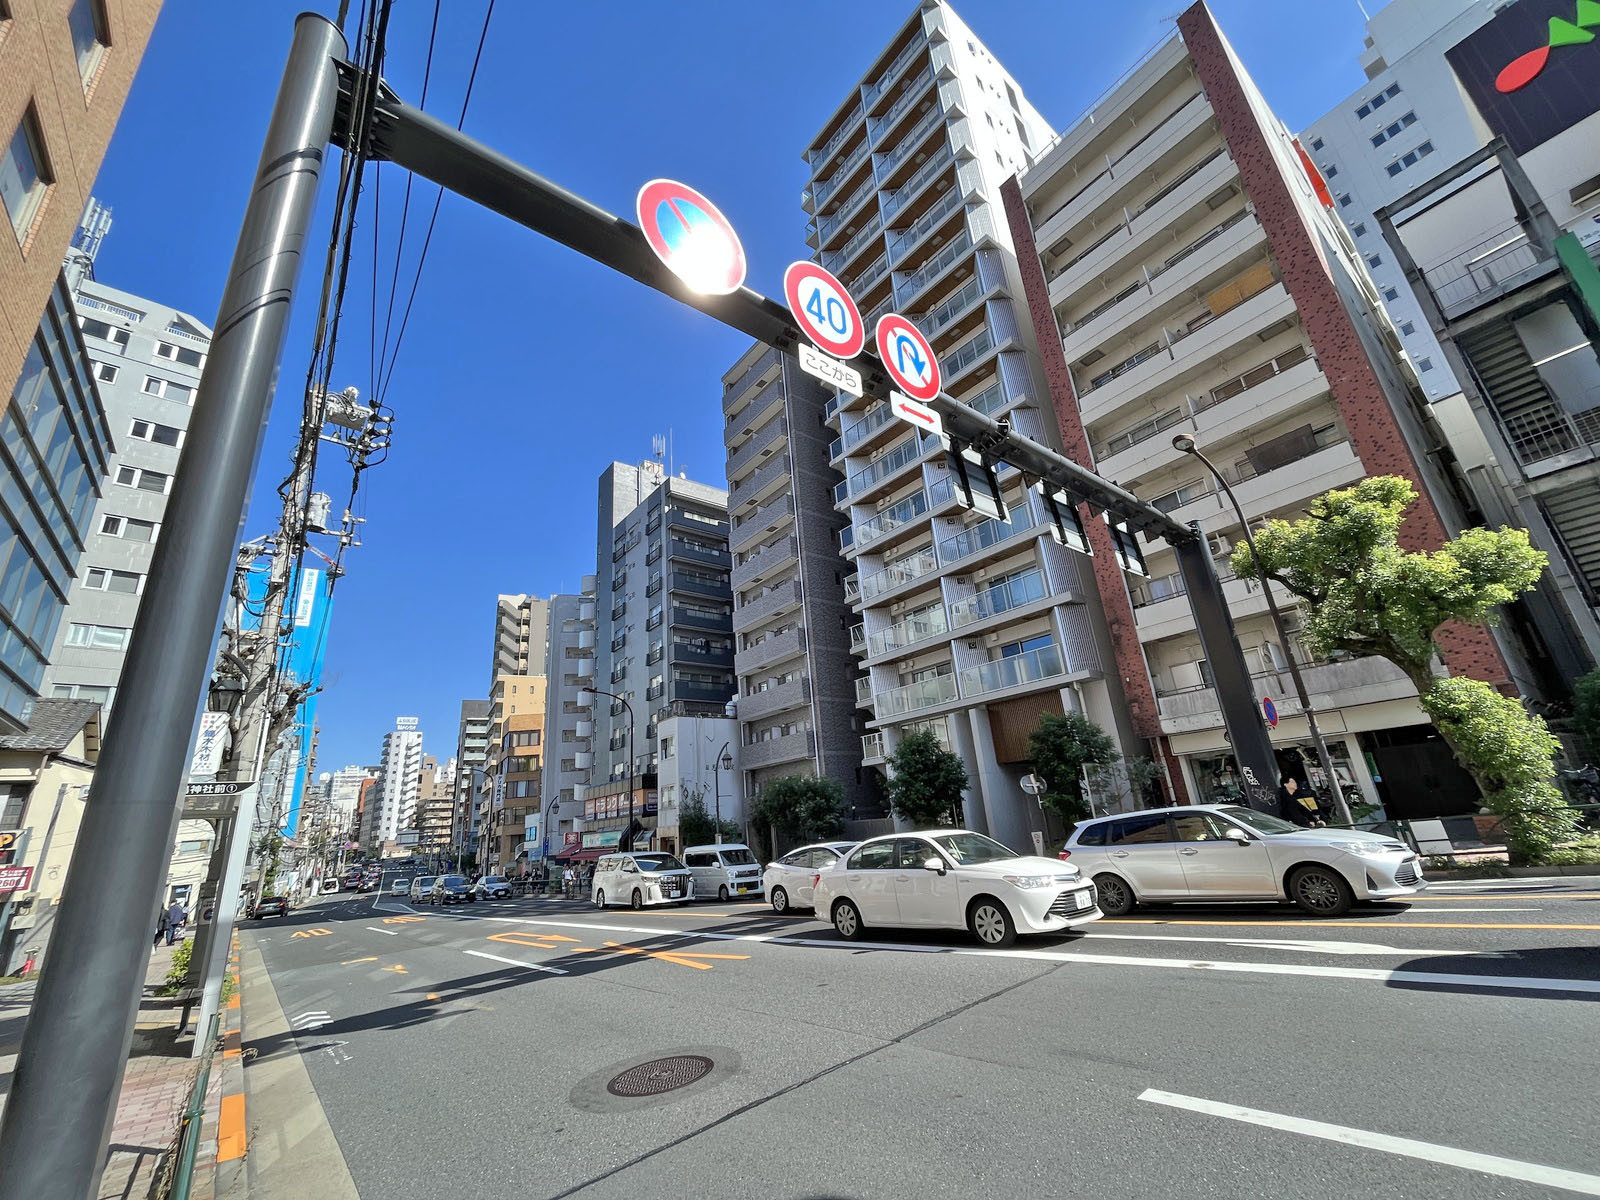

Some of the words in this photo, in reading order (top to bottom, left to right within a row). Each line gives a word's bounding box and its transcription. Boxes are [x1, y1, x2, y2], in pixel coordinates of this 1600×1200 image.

[806, 288, 847, 335] 40
[806, 353, 857, 388] ここから
[290, 928, 334, 938] 40
